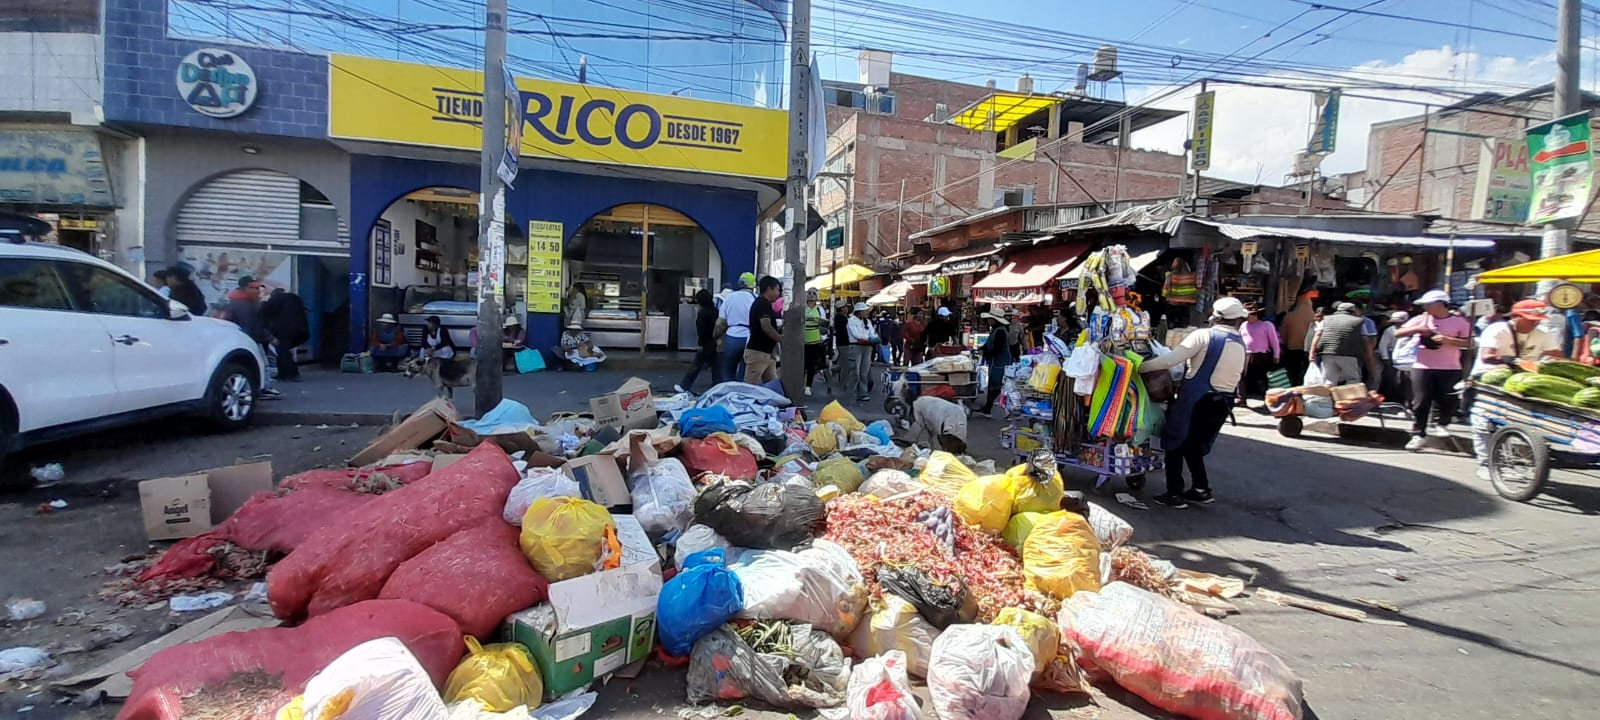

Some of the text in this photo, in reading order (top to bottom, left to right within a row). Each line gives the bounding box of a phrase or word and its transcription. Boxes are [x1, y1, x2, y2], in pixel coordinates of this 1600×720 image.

[436, 95, 483, 117] TIEND
[520, 90, 662, 150] RICO
[667, 121, 740, 146] DESDE 1967
[1494, 141, 1530, 173] PLA
[164, 503, 189, 517] Angel
